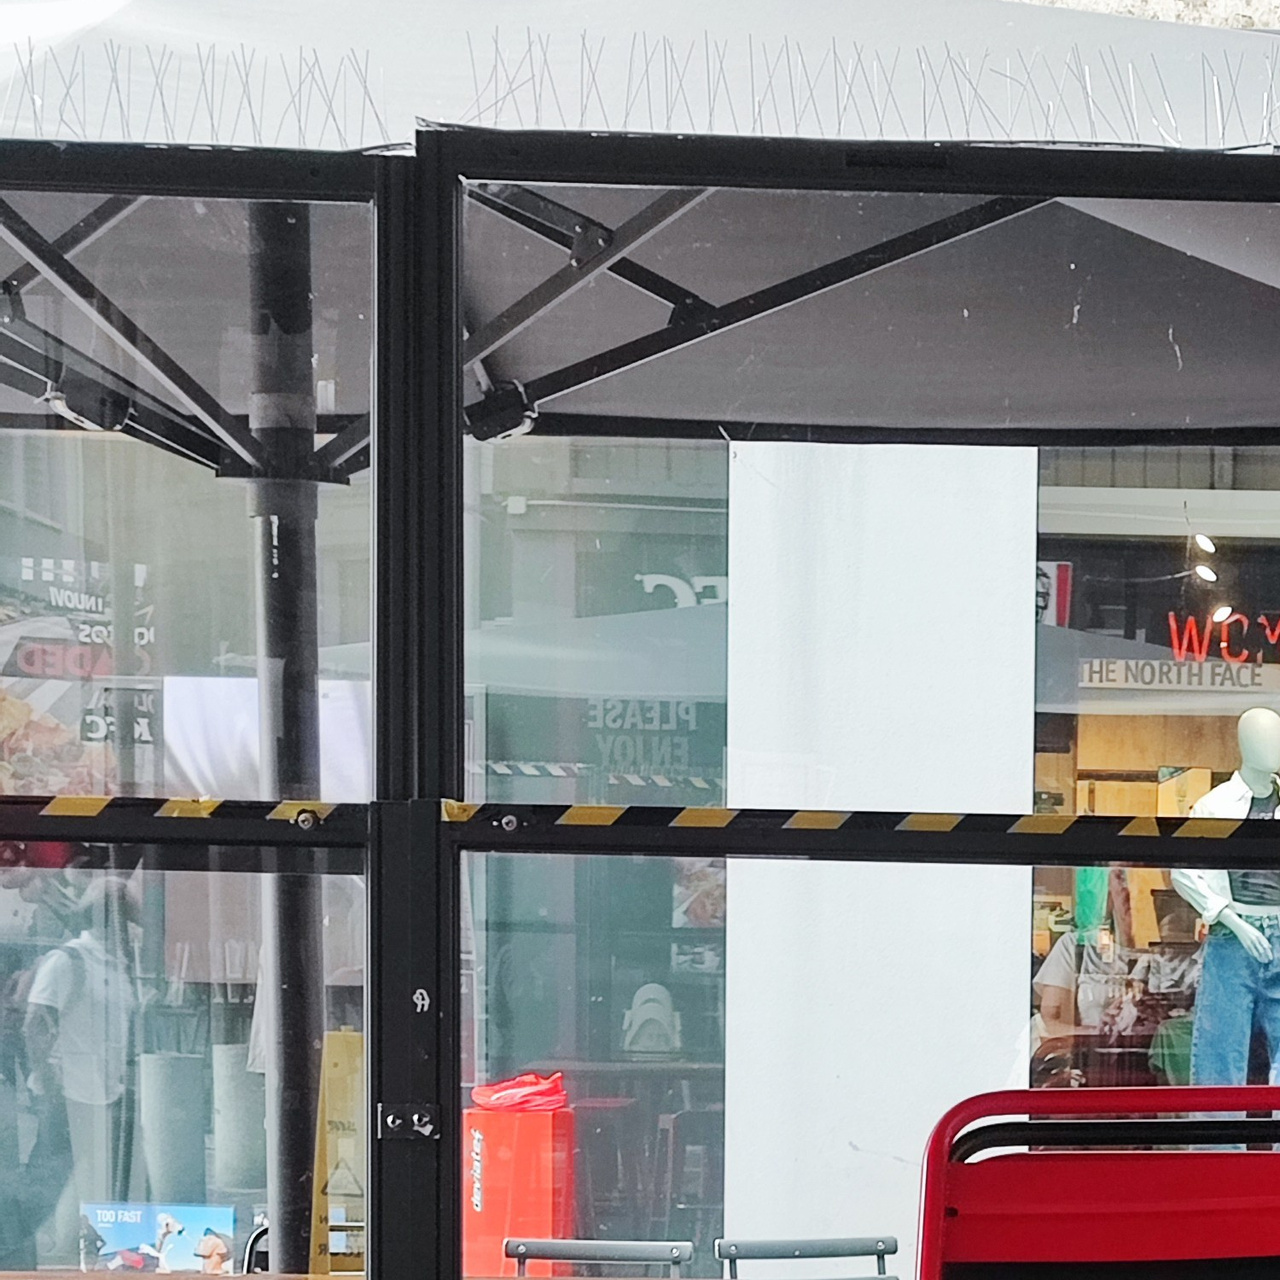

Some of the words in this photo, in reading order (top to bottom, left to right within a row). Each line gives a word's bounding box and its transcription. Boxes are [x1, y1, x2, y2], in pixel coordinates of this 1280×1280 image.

[1125, 661, 1203, 686] NORTH
[1211, 663, 1263, 687] FACE
[96, 1210, 115, 1222] TOO
[118, 1210, 142, 1223] FAST
